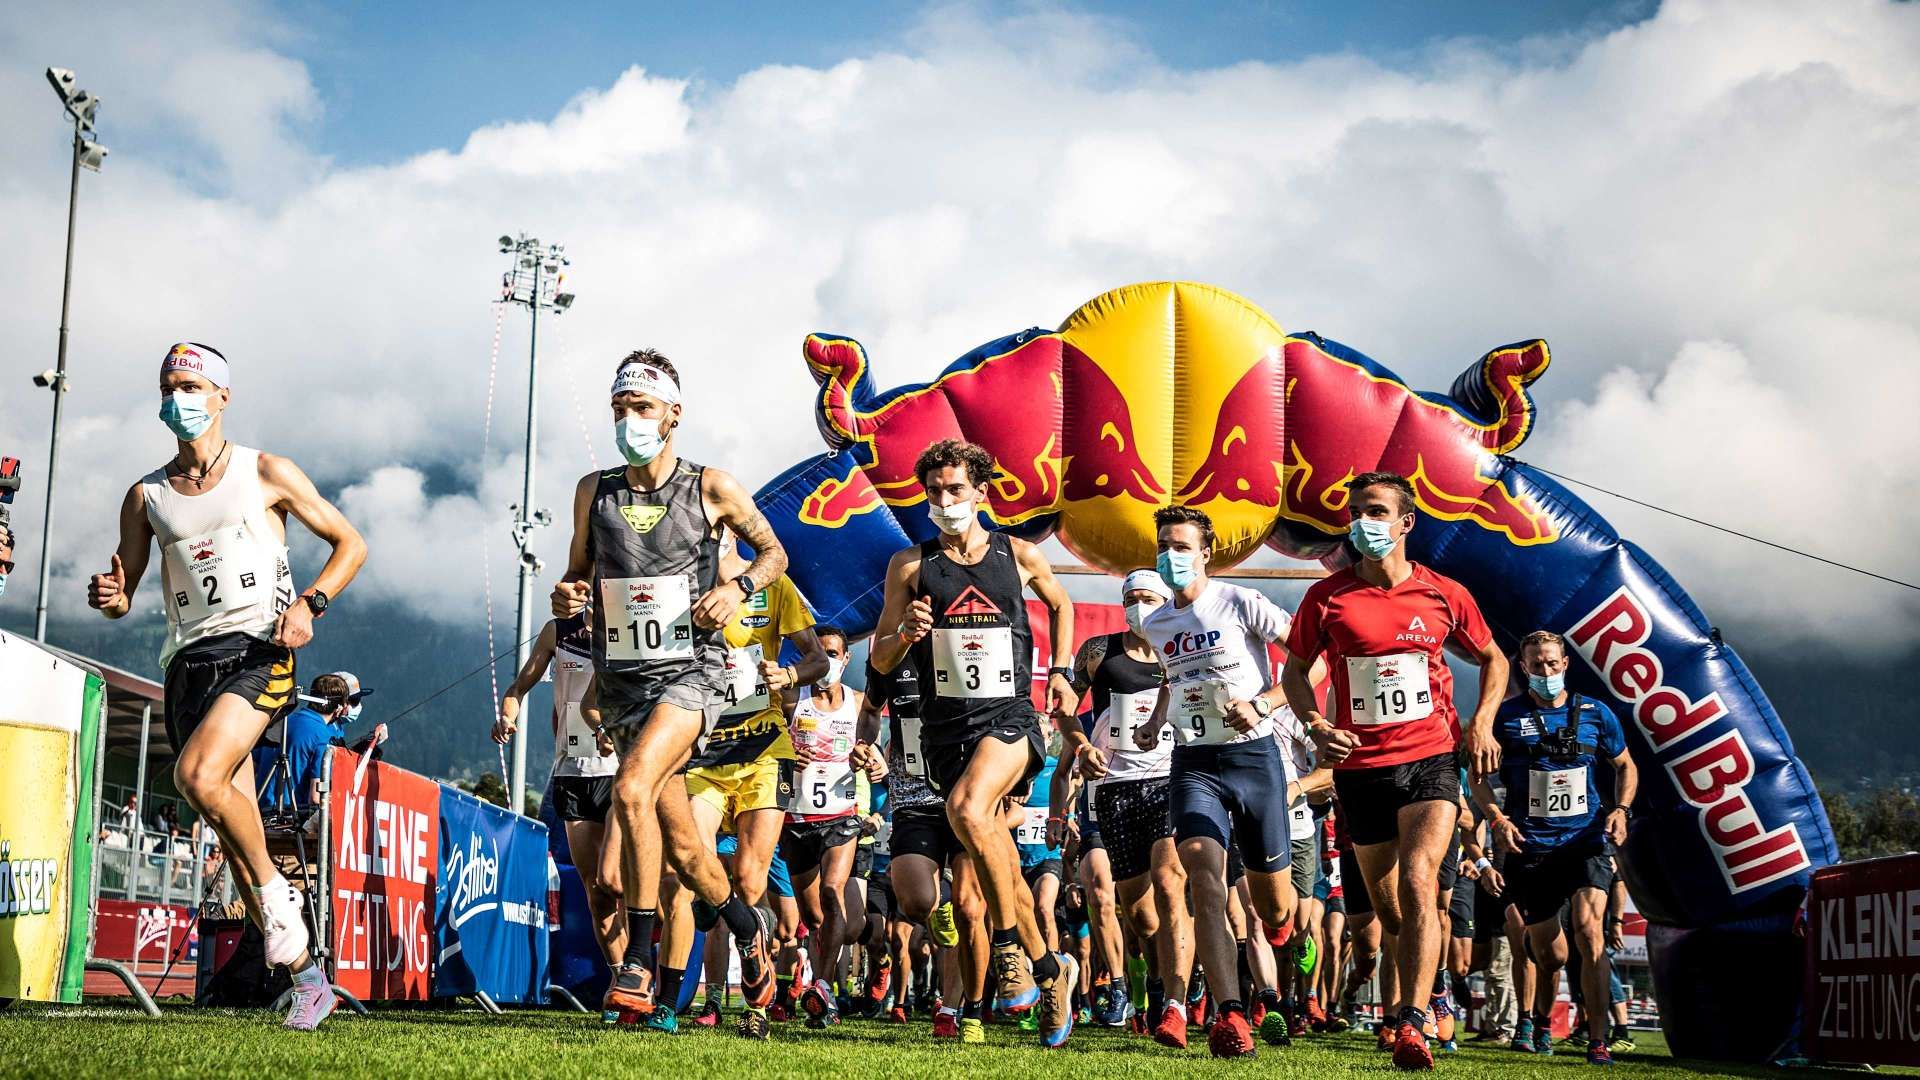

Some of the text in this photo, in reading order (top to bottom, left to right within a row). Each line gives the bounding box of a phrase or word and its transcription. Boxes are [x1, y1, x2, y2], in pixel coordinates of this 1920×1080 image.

[179, 358, 203, 371] Bull
[188, 539, 213, 551] Red Bull
[188, 556, 223, 571] DOLOMITEN
[198, 565, 217, 574] MANN
[202, 575, 222, 606] 2
[642, 583, 654, 591] Bull
[625, 603, 661, 611] DOLOMITEN
[949, 616, 969, 624] NIKE
[627, 619, 661, 650] 10
[1182, 631, 1221, 652] ČPP
[1396, 633, 1436, 644] AREVA
[1181, 654, 1207, 665] INSURANCE
[1207, 650, 1226, 658] GROUP
[966, 664, 980, 690] 3
[1373, 676, 1405, 684] DOLOMITEN
[724, 683, 738, 707] 4
[1375, 689, 1407, 716] 19
[1191, 714, 1205, 737] 9
[1567, 589, 1808, 891] Red Bull
[813, 782, 827, 809] 5
[1548, 793, 1571, 812] 20
[340, 791, 429, 885] KLEINE
[1031, 826, 1047, 839] 75
[0, 840, 58, 917] össer
[337, 889, 428, 973] ZEITUNG
[1820, 889, 1920, 961] KLEINE
[1818, 972, 1920, 1042] ZEITUNG
